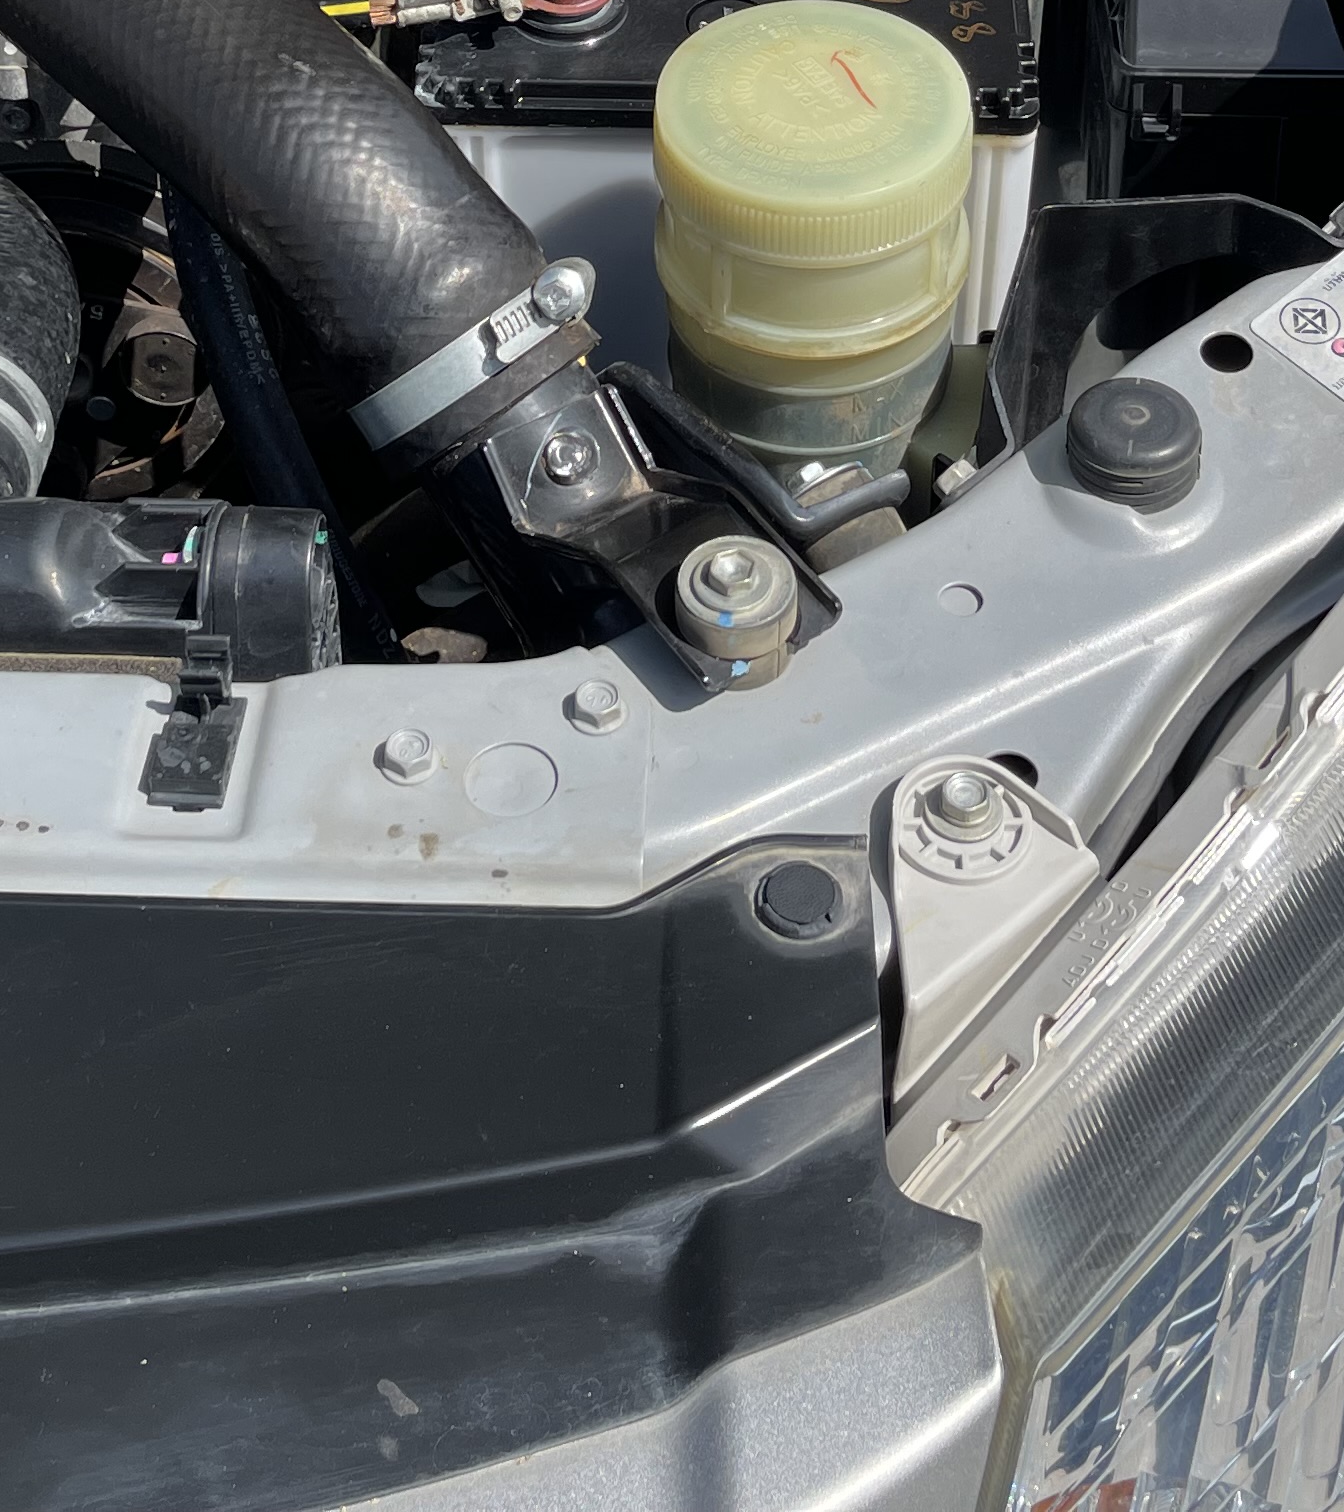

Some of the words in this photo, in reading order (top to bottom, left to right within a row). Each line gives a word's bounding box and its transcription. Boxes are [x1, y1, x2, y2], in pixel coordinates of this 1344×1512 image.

[731, 39, 796, 106] CAUTION
[725, 124, 807, 161] EMPLOYER
[749, 107, 883, 144] ATTENTION
[1062, 954, 1095, 988] ADJ
